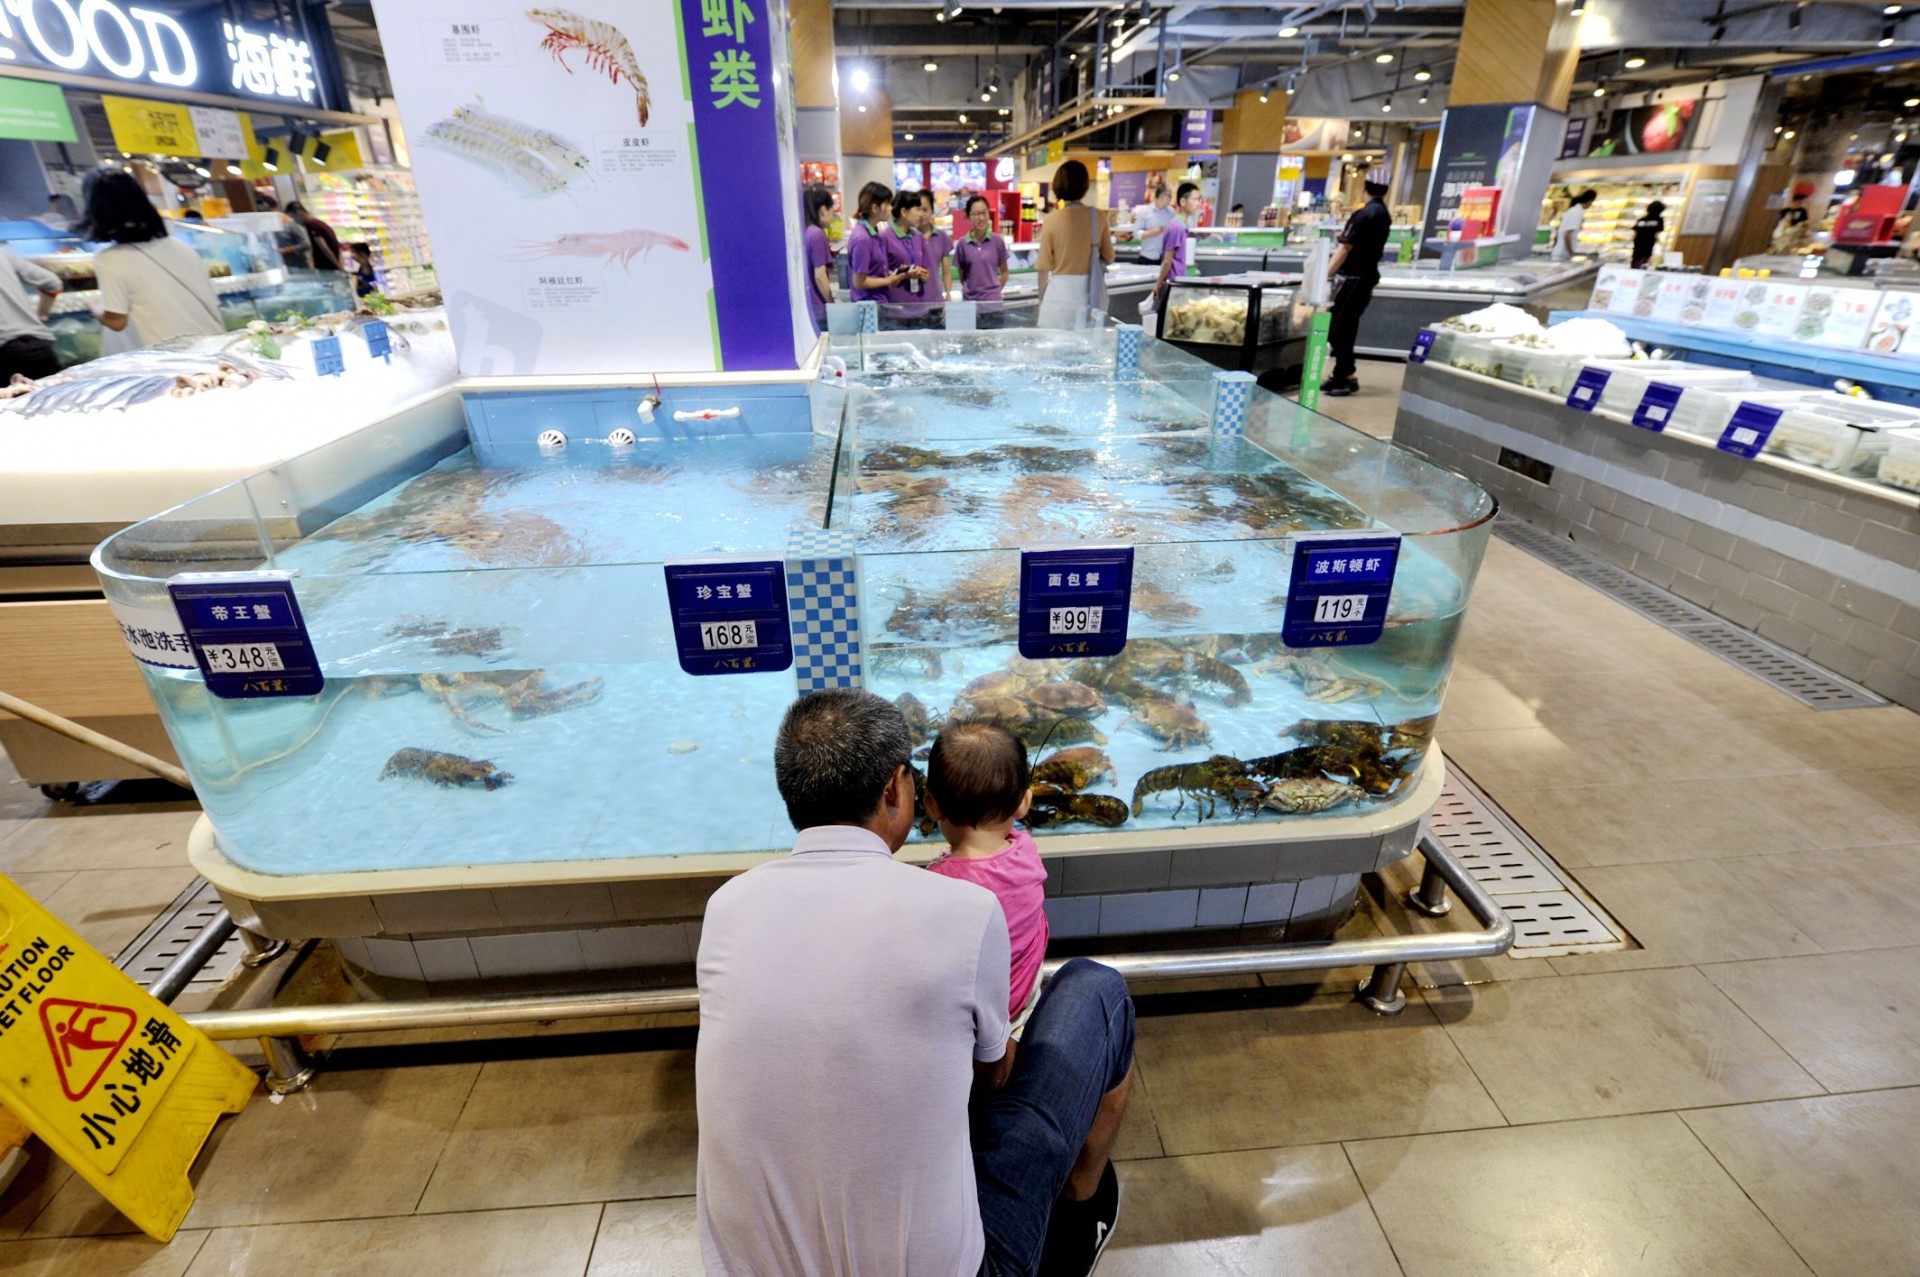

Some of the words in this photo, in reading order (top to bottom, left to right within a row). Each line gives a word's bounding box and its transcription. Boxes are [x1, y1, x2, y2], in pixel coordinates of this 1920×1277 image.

[451, 23, 480, 35] 基围虾
[223, 20, 316, 103] 海鲜
[700, 0, 761, 109] 虾类
[622, 137, 650, 148] 皮皮虾
[538, 276, 583, 285] 阿根廷红虾
[1314, 557, 1382, 574] 波斯顿虾
[1048, 572, 1100, 587] 面包蟹
[696, 583, 752, 600] 珍宝蟹
[211, 604, 273, 622] 帝王蟹
[1320, 598, 1352, 619] 119
[1052, 610, 1087, 630] ¥99
[705, 625, 742, 647] 168
[0, 936, 50, 999] UTION
[18, 945, 76, 1005] FLOOR
[81, 1017, 183, 1151] 小心地滑
